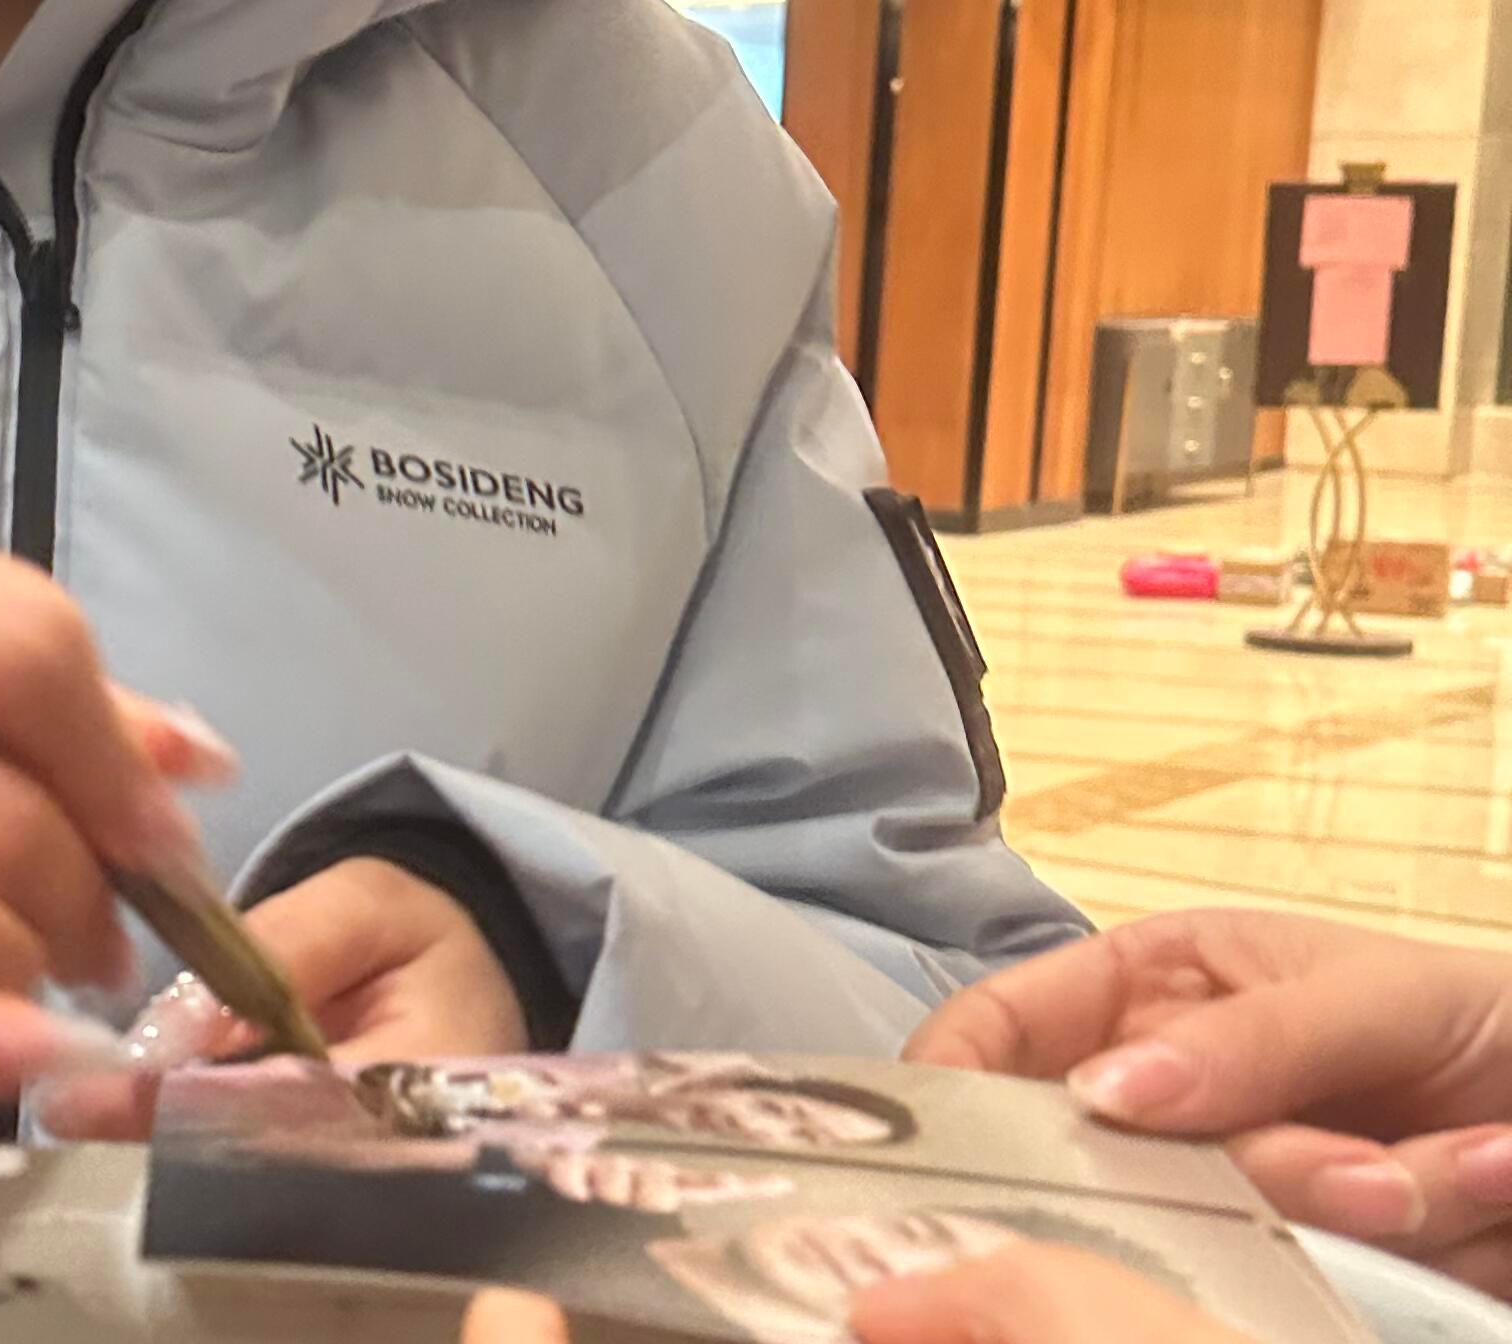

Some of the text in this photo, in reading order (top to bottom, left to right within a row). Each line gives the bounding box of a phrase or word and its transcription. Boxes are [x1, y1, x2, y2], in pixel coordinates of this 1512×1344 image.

[370, 446, 585, 517] BOSIDENG
[376, 484, 557, 537] SNOW COLLECTION
